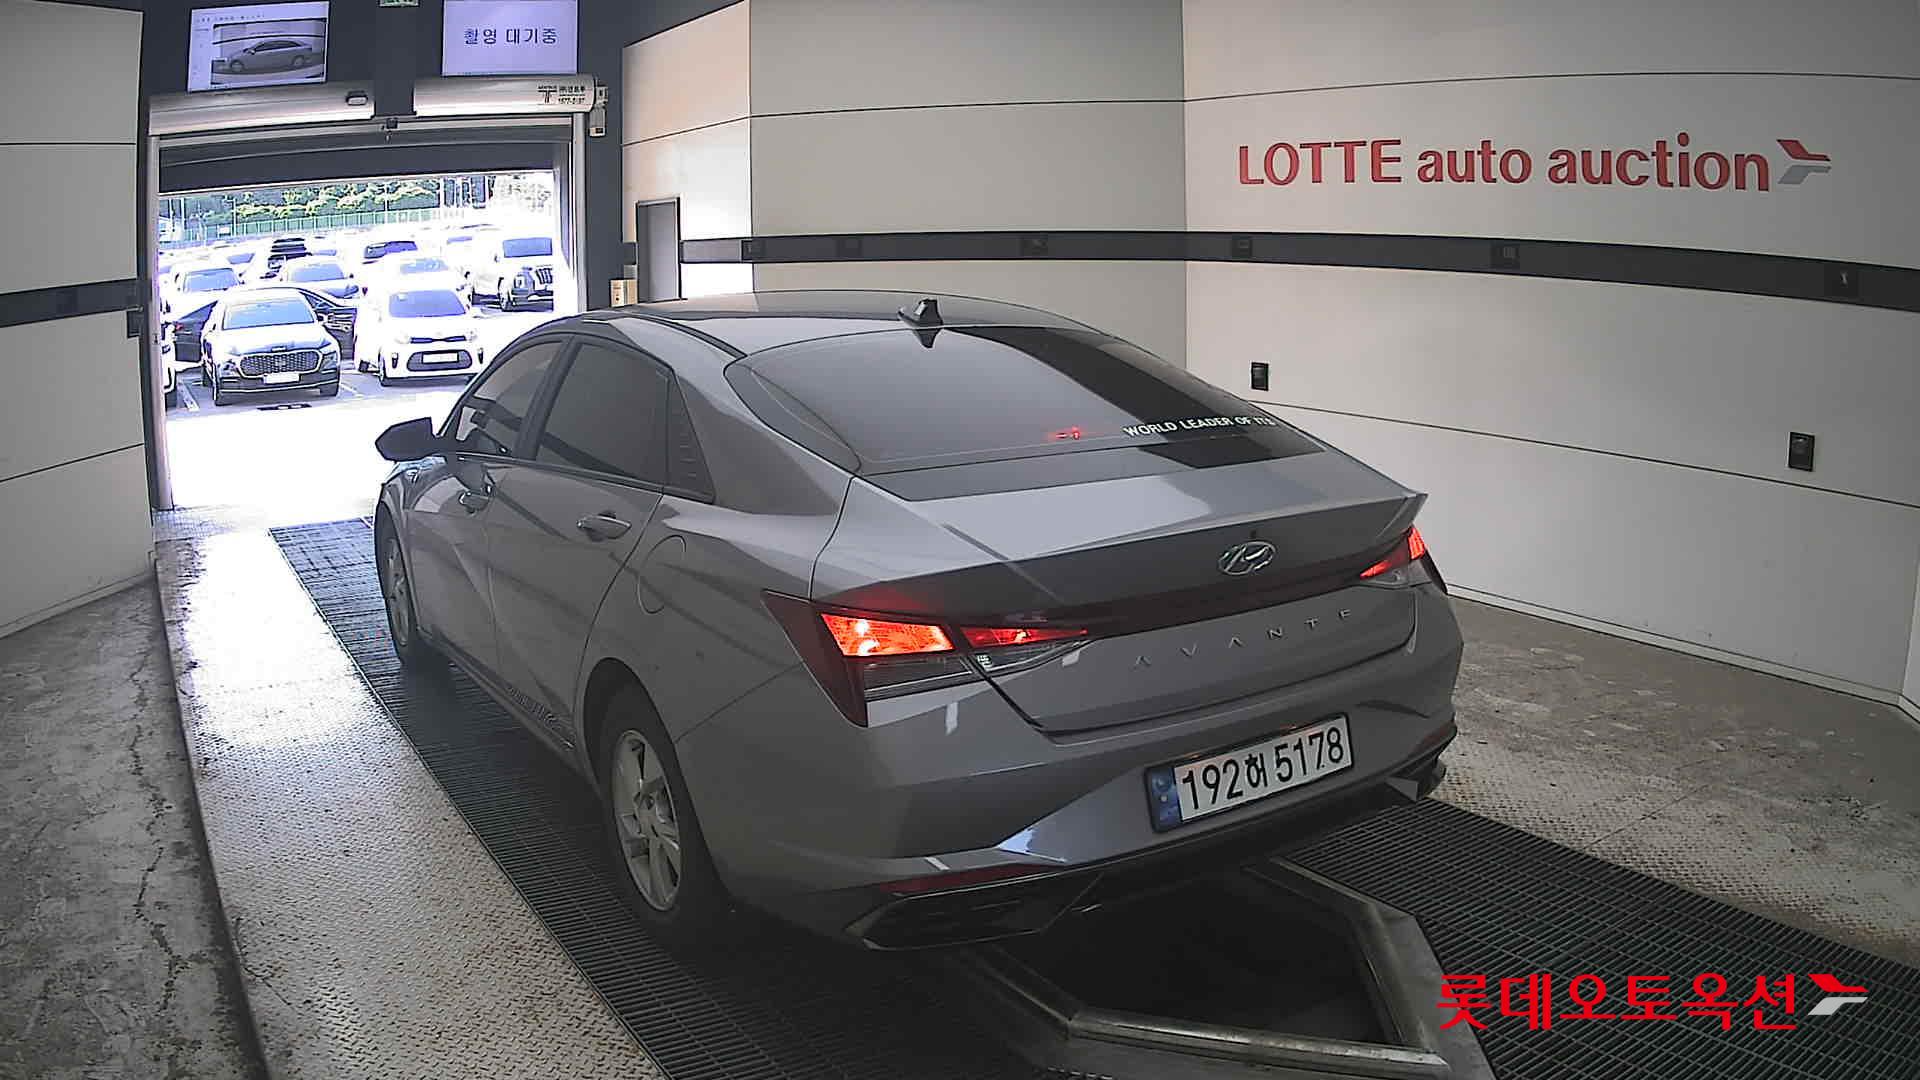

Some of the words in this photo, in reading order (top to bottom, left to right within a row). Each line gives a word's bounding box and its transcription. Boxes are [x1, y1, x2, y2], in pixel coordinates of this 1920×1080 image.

[505, 27, 558, 45] 대기중
[1239, 138, 1402, 185] LOTTE
[1416, 139, 1533, 185] auto
[1547, 131, 1770, 192] auction
[1123, 421, 1178, 437] WORLD
[1179, 416, 1234, 430] LEADER
[1234, 415, 1252, 425] OF
[1133, 608, 1351, 670] AVANTE
[1181, 752, 1269, 811] 192허
[1274, 727, 1345, 784] 5178
